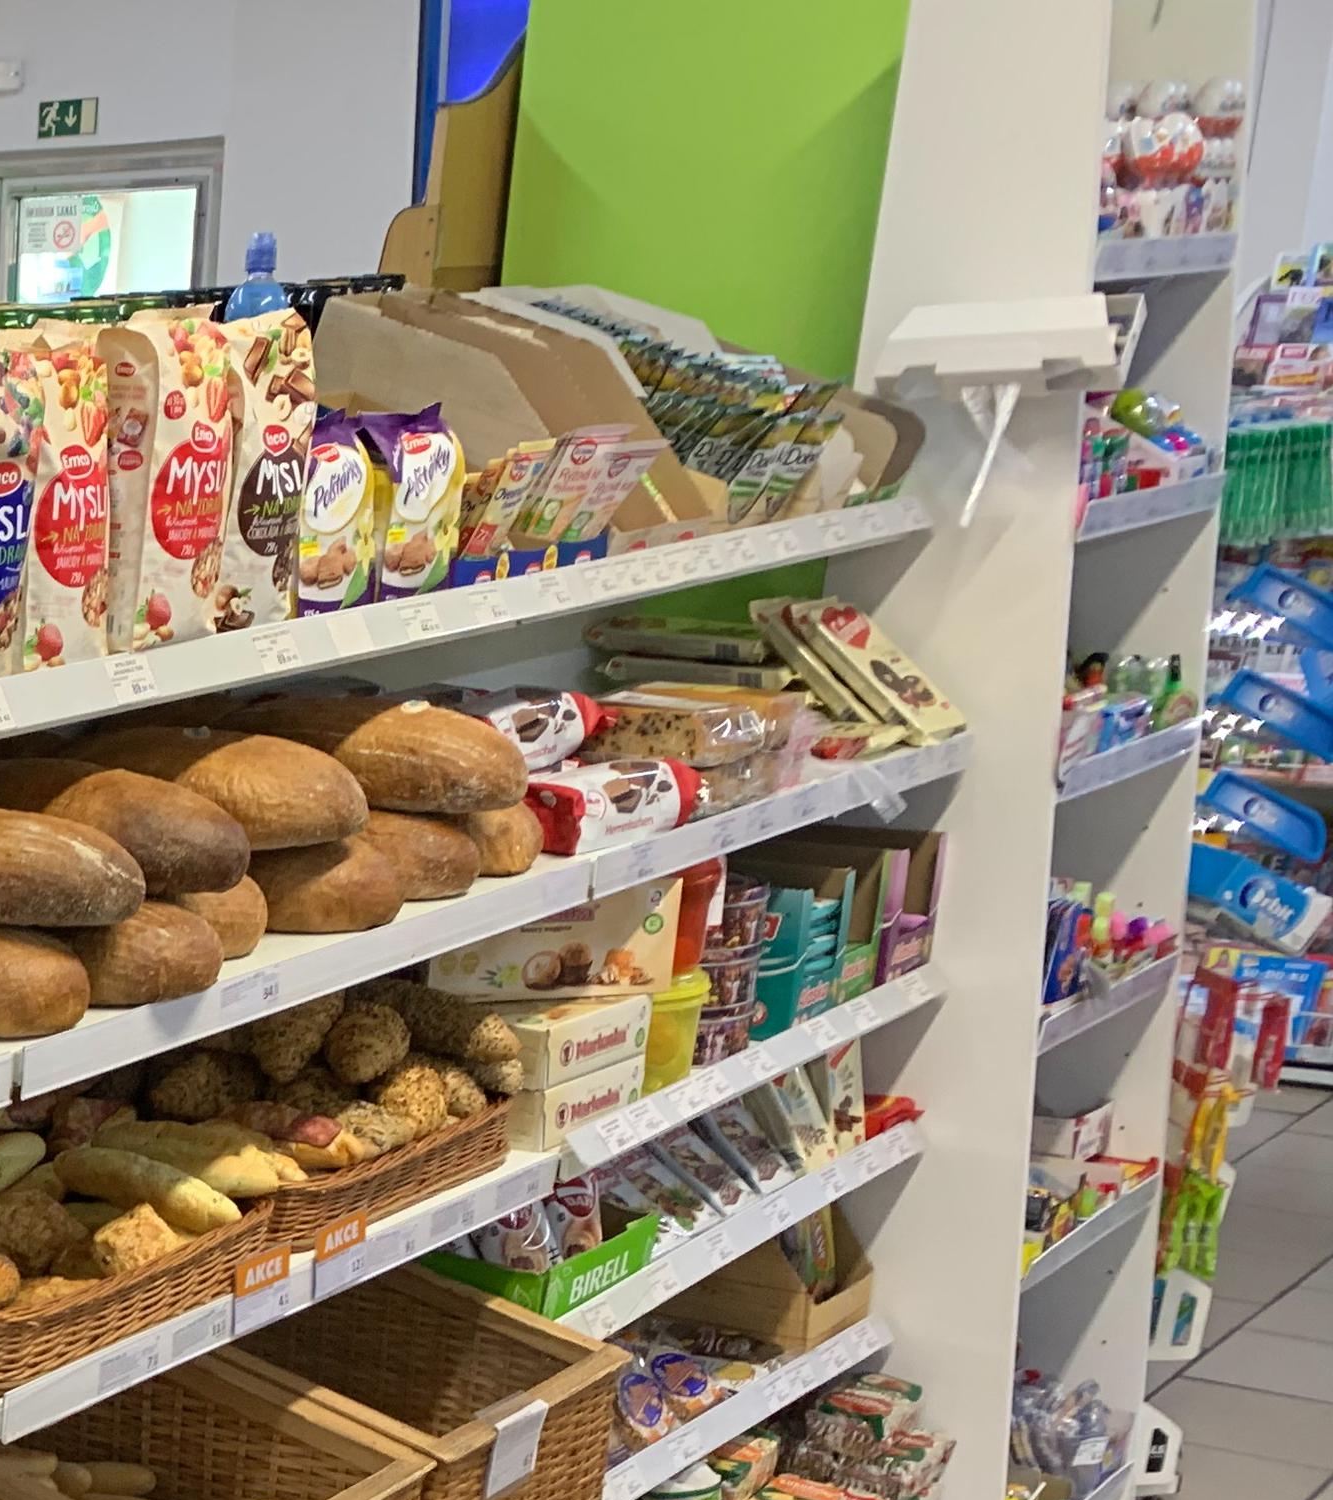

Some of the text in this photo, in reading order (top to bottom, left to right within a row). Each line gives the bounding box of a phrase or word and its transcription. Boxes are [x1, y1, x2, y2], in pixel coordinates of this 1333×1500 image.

[61, 453, 91, 470] Emco
[52, 481, 108, 533] MYSL
[324, 1218, 360, 1254] AKCE
[244, 1256, 284, 1290] AKCE
[568, 1251, 631, 1305] BIRELL
